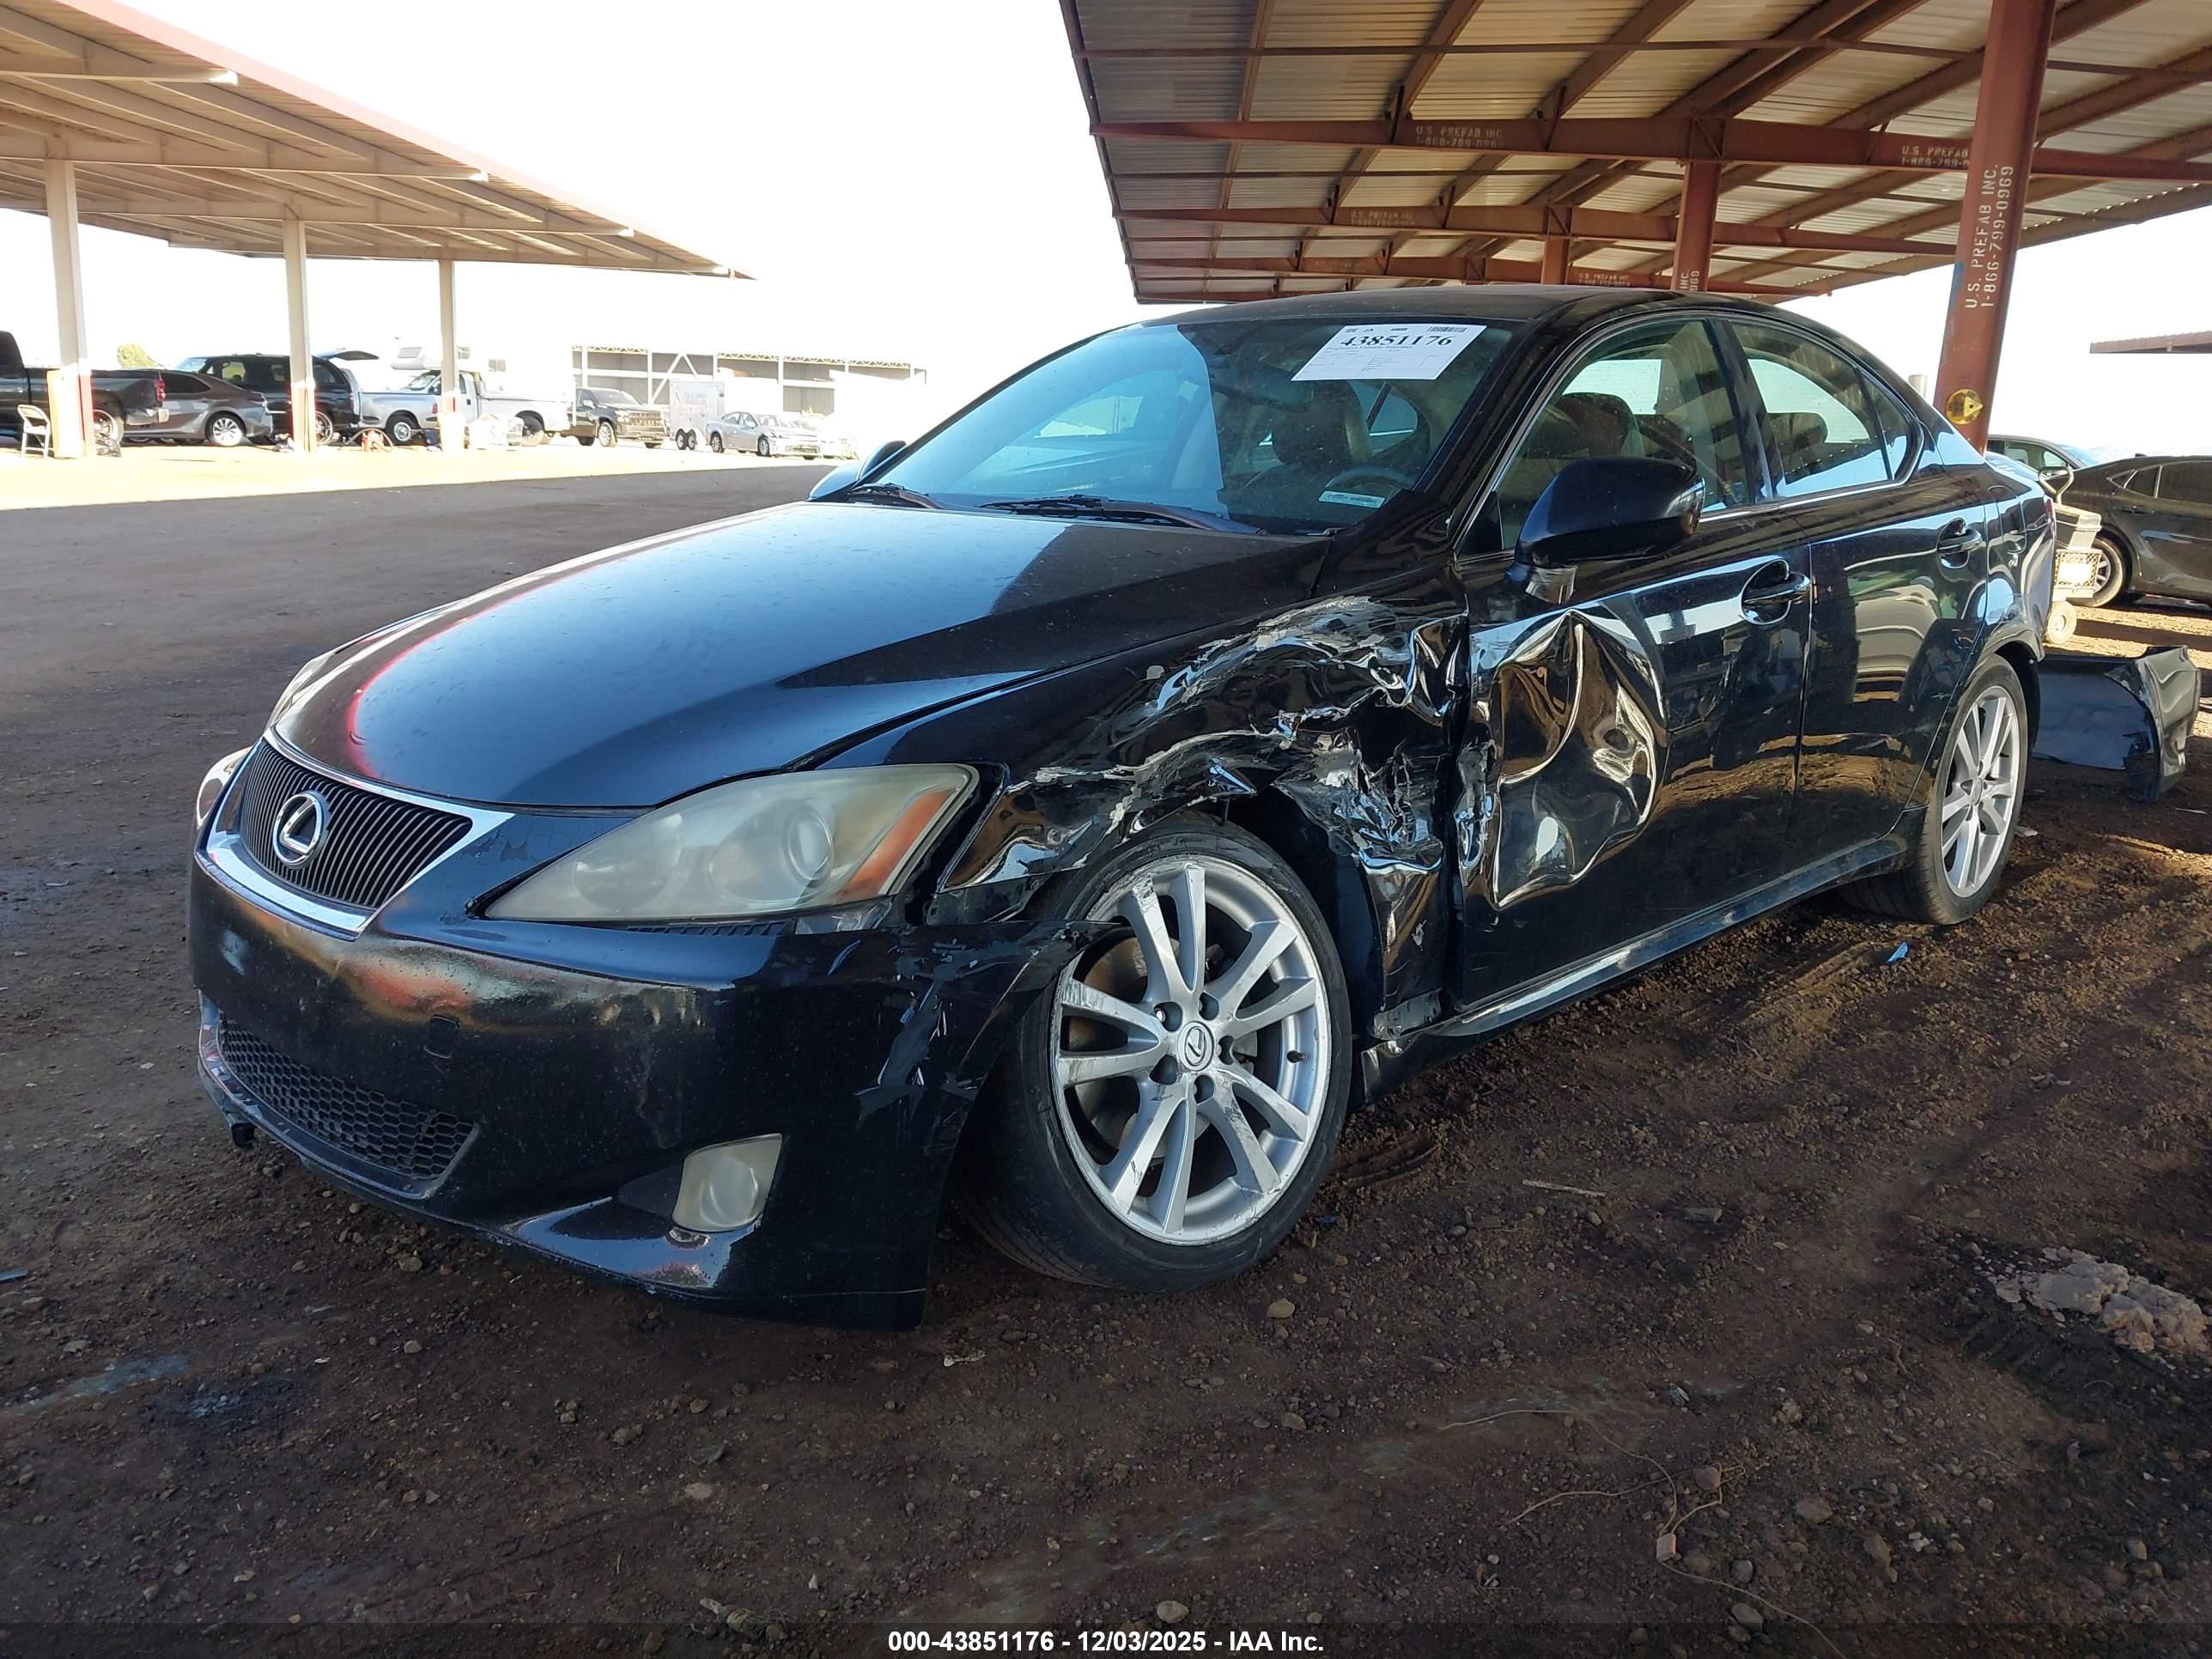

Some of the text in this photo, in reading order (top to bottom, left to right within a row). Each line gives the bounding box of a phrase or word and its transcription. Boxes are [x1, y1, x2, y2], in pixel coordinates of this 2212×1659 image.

[1441, 126, 1481, 137] PREFAB
[1928, 146, 1969, 158] PREFAB
[1965, 164, 1998, 308] U.S. PREFAB INC.
[1980, 166, 2014, 307] 1-866-799-0969
[1340, 335, 1457, 346] 43851176
